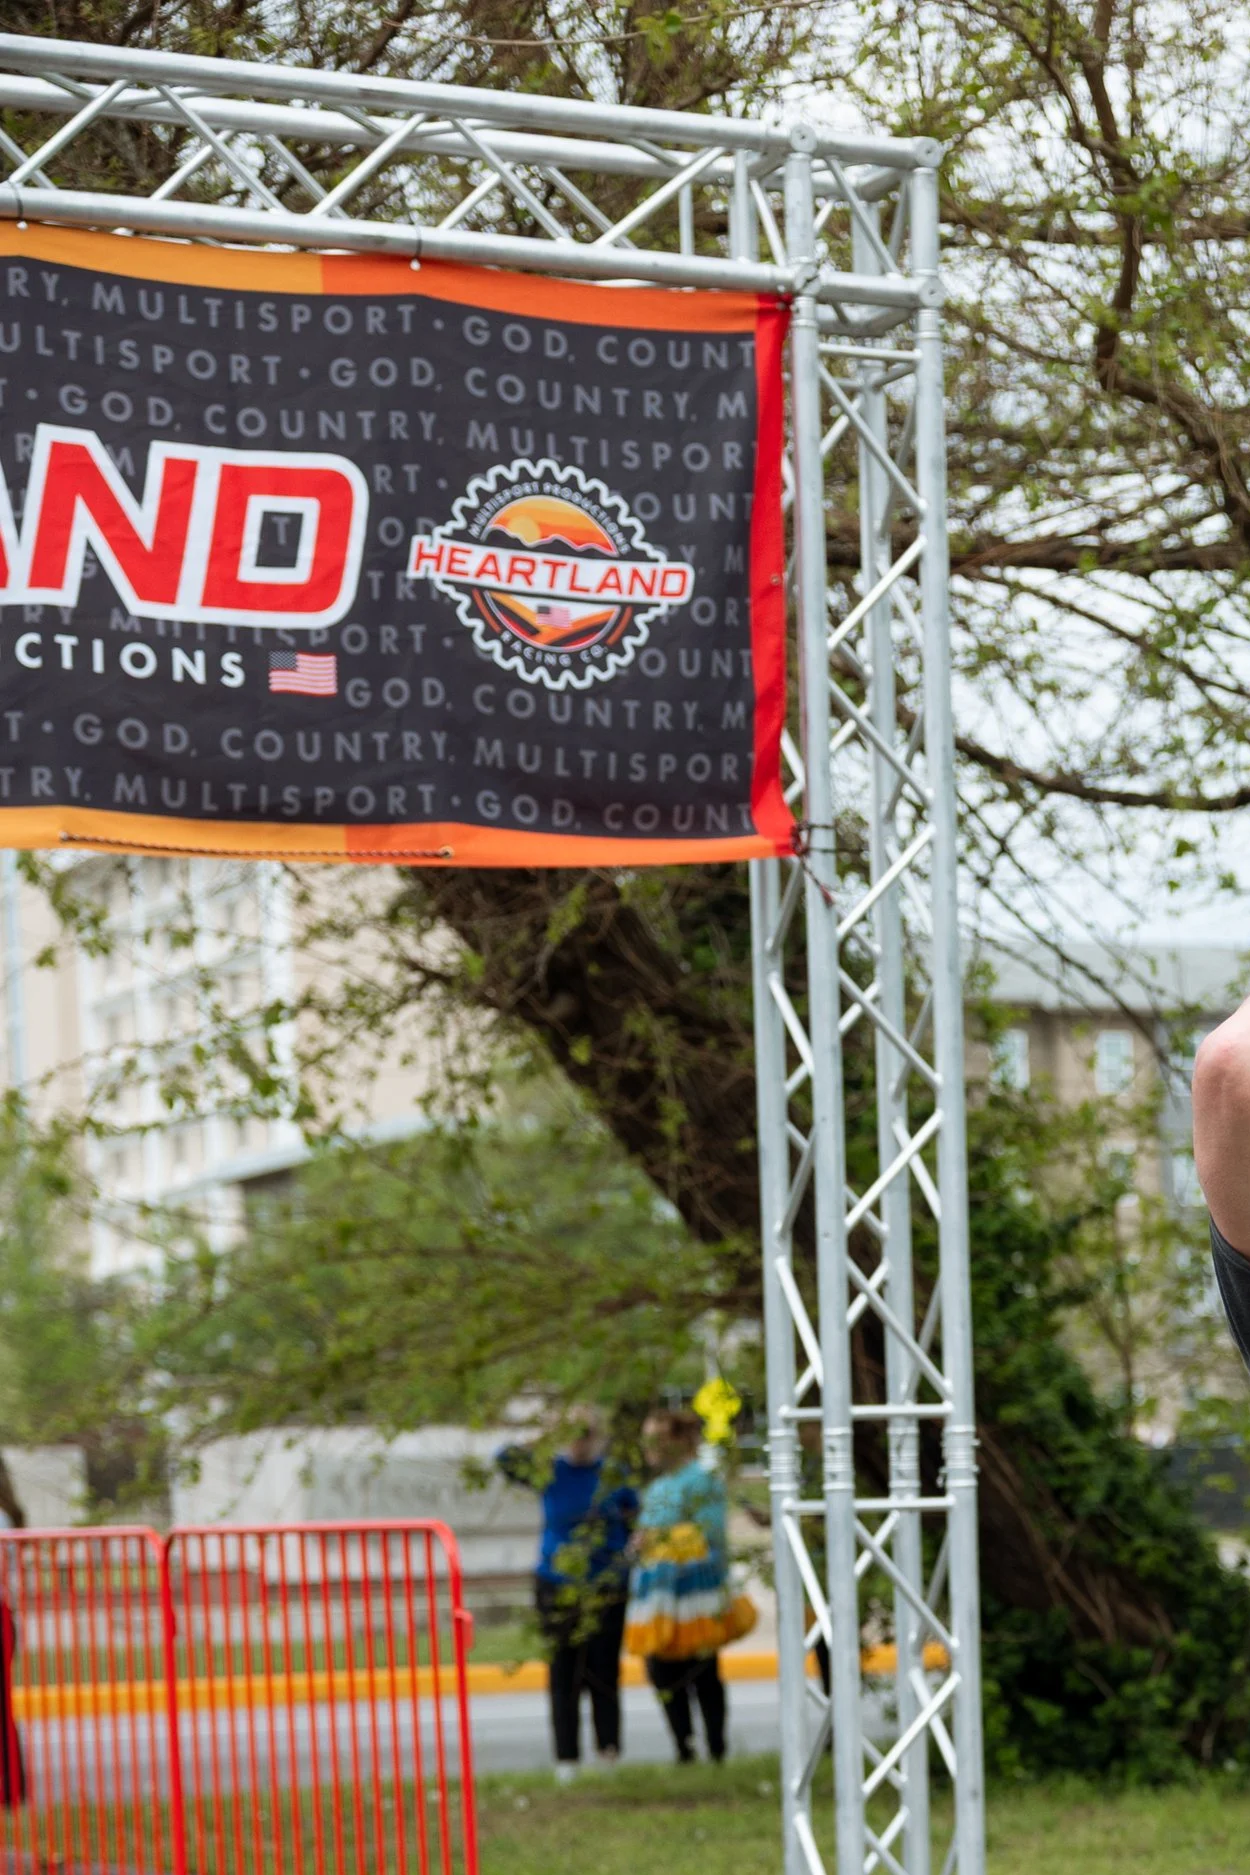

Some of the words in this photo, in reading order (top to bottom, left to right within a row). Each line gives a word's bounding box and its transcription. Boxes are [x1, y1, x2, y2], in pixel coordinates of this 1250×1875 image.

[92, 282, 417, 334] MULTISPORT
[466, 421, 757, 472] MULTISPOR
[412, 539, 691, 599] HEARTLAND
[15, 631, 246, 689] CTIONS
[473, 736, 755, 783] MULTISPOR
[114, 772, 435, 817] MULTISPORT
